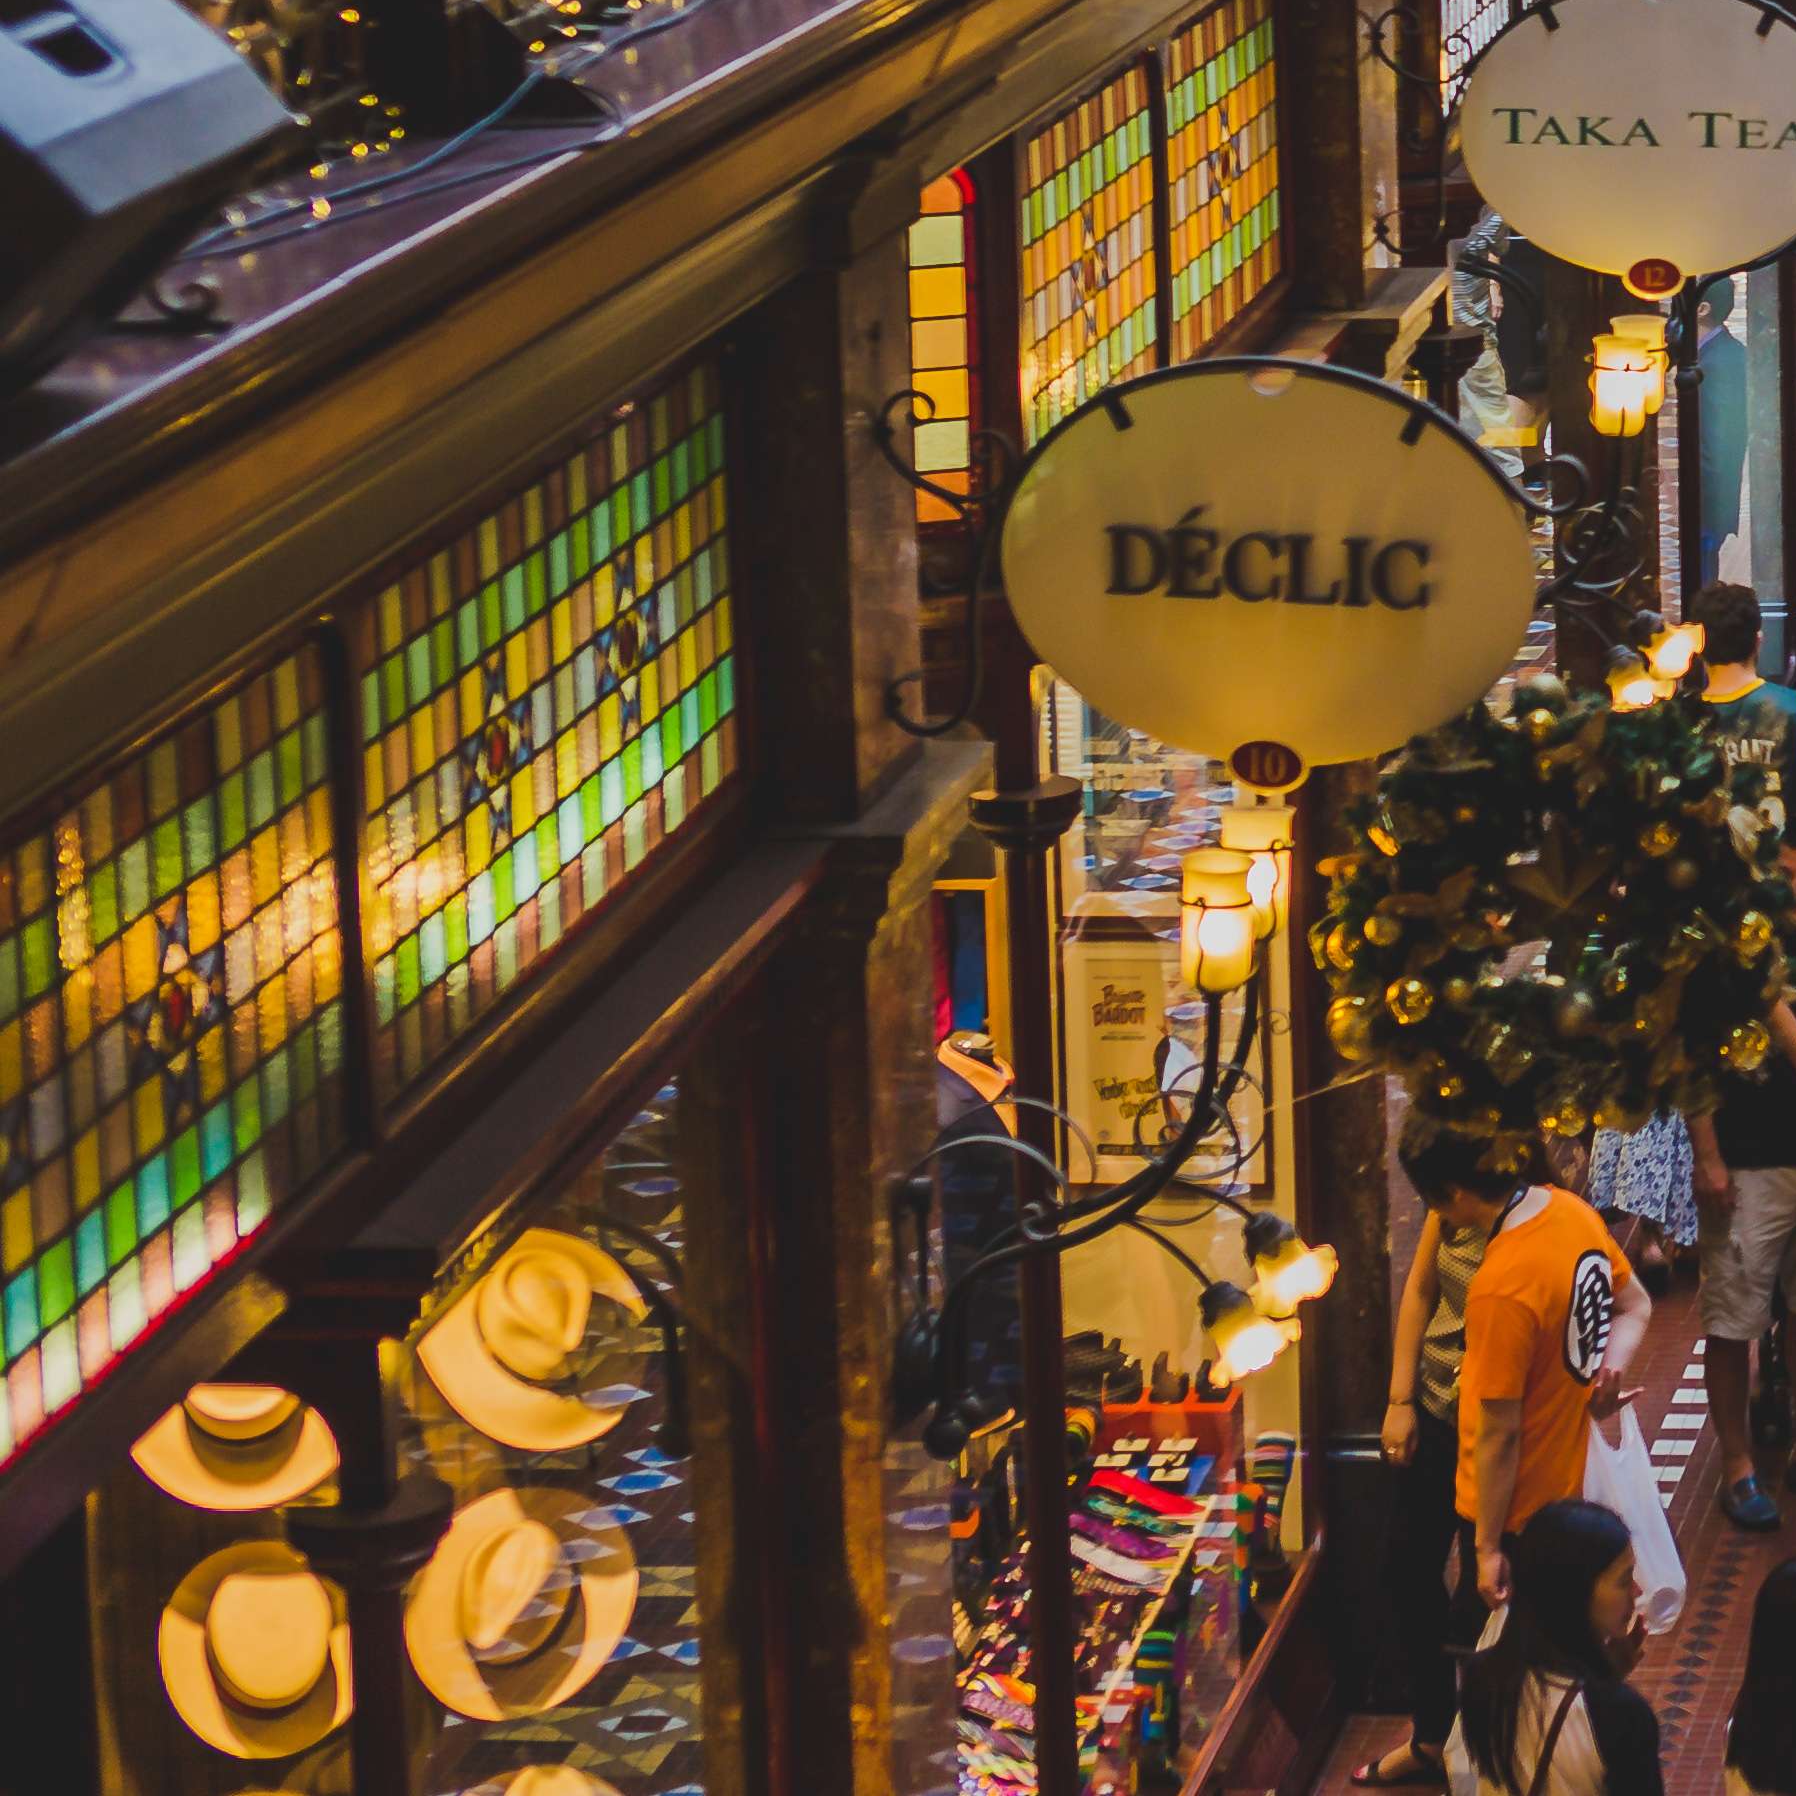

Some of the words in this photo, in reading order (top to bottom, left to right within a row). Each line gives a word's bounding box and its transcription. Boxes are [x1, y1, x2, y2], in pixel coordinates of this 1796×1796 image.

[1491, 107, 1663, 148] TAKA
[1643, 267, 1666, 288] 12
[1103, 503, 1433, 612] DÉCLIC
[1249, 753, 1287, 784] 10
